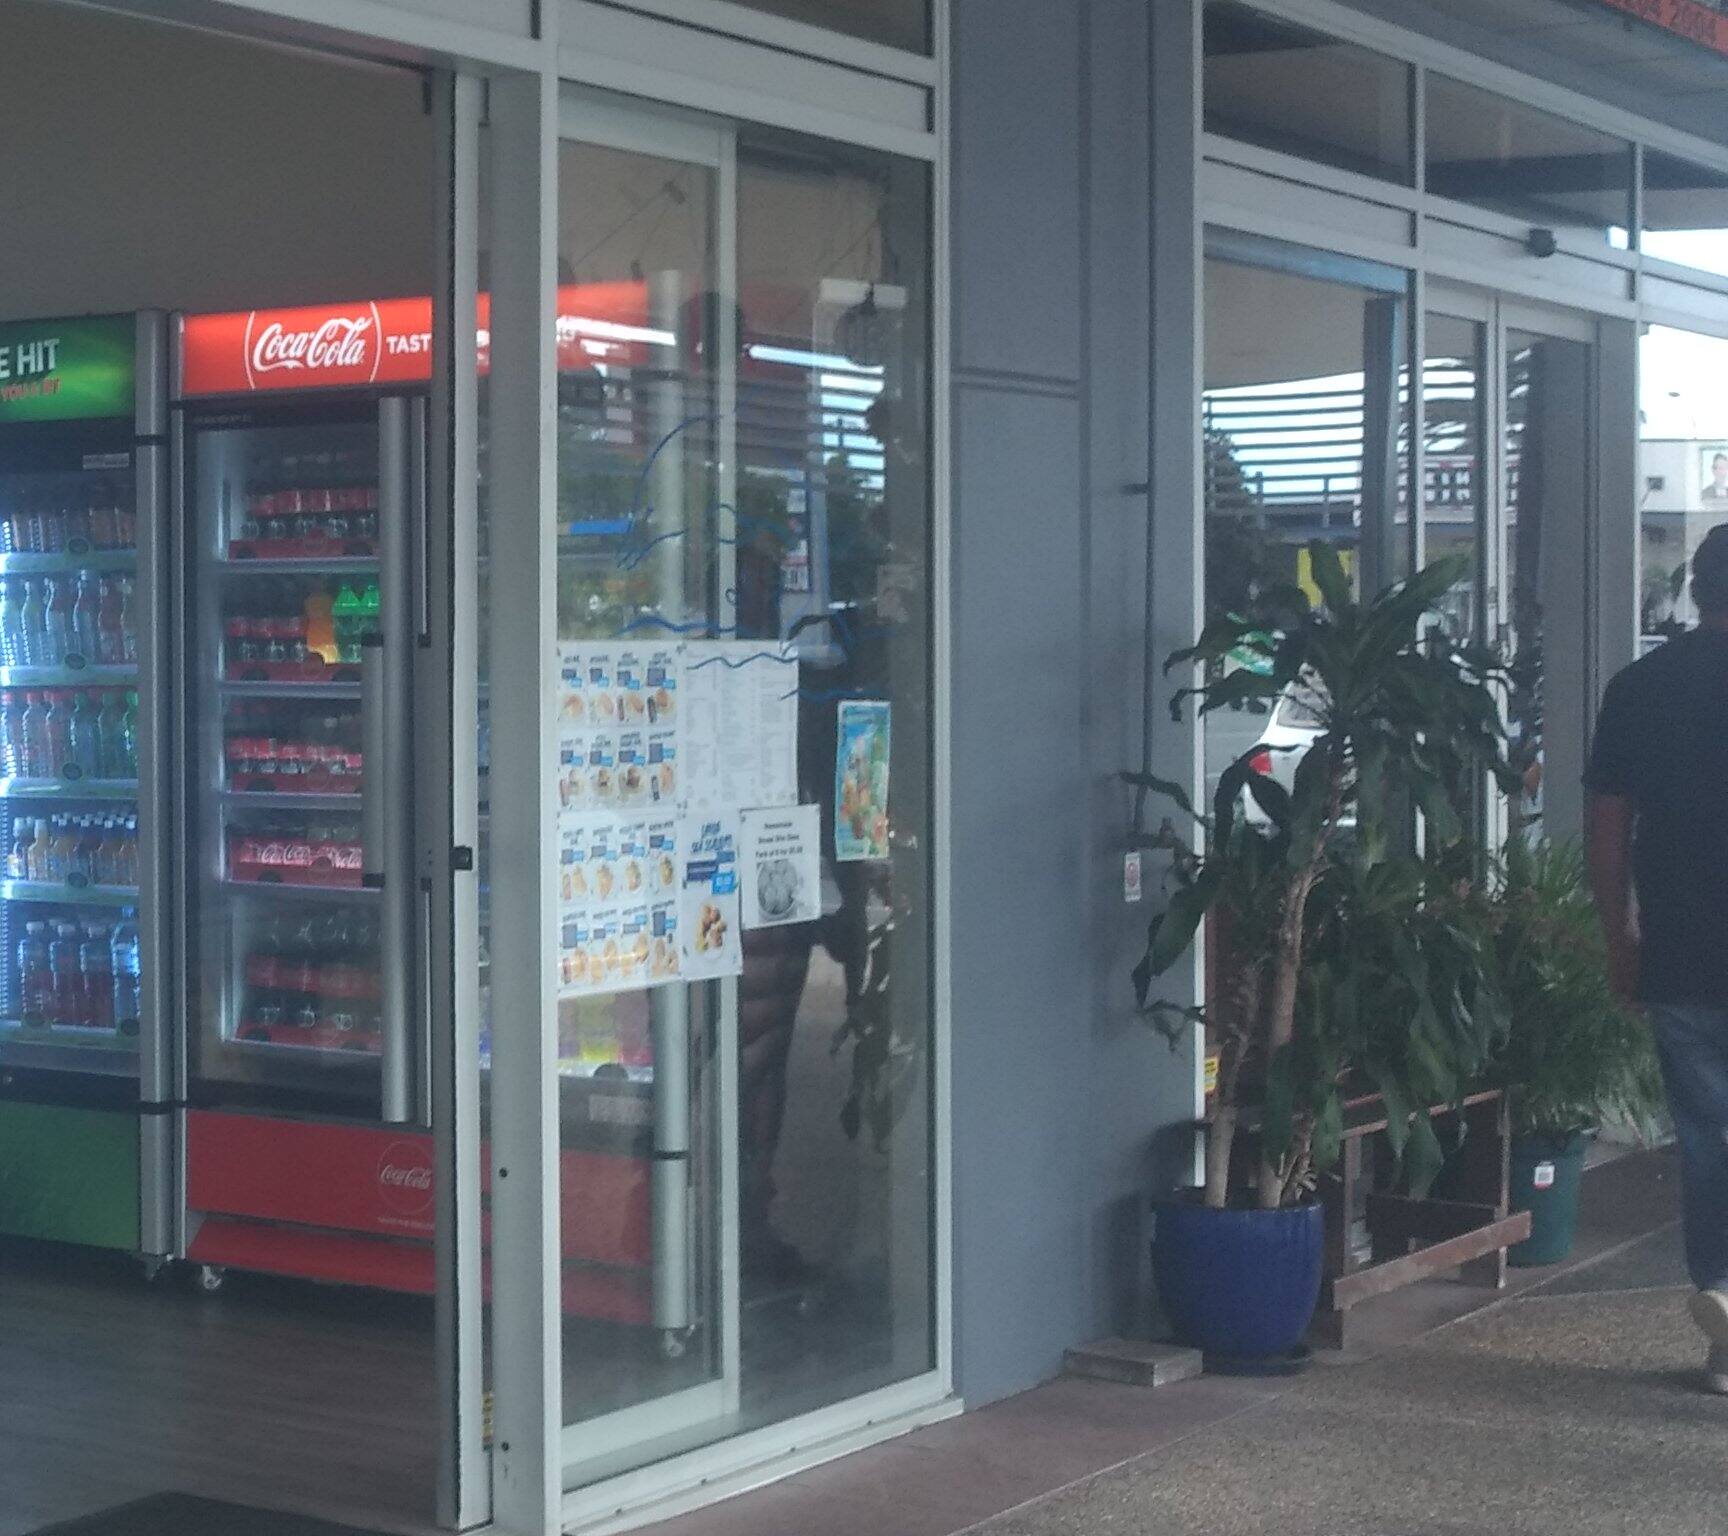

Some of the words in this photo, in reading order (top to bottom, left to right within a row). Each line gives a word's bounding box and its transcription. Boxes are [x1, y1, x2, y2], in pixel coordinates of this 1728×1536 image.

[16, 337, 60, 376] HIT
[253, 317, 374, 372] Coca-Cola
[386, 332, 432, 355] TAST
